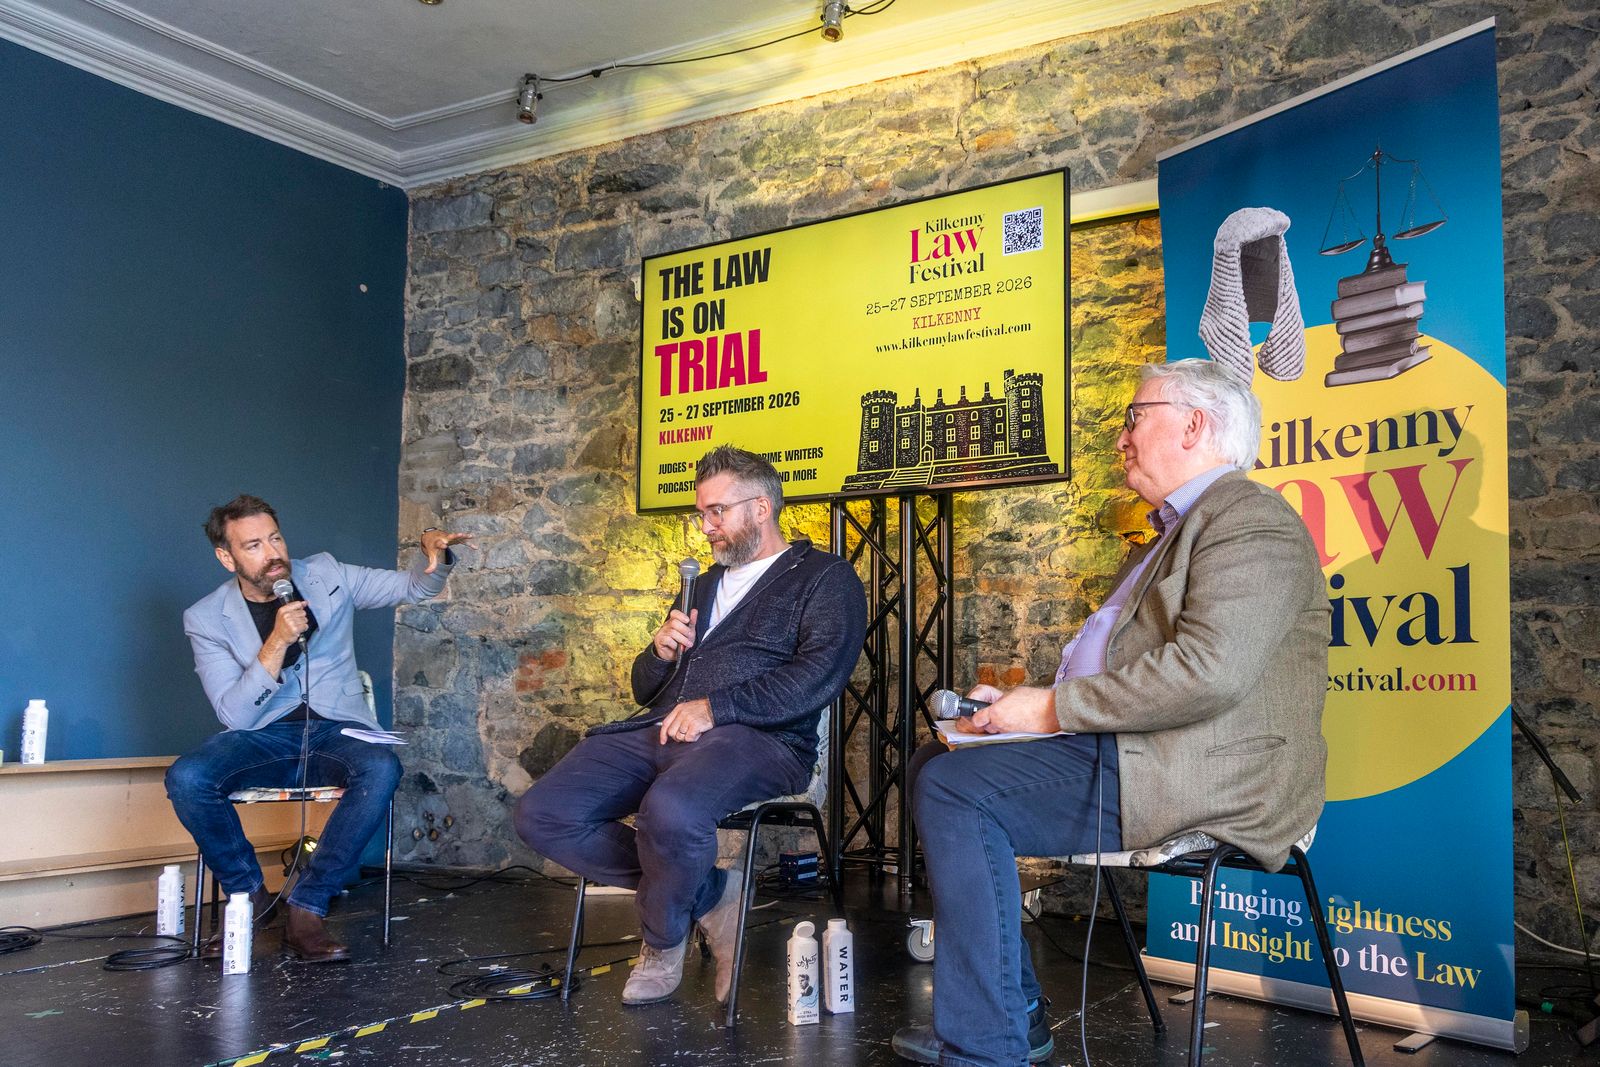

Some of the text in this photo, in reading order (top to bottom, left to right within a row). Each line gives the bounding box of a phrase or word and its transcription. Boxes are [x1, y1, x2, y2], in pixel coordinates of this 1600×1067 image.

[925, 213, 985, 234] Kilkenny
[909, 227, 985, 264] Law
[659, 248, 771, 301] THE LAW
[909, 253, 985, 284] Festival
[910, 283, 991, 308] SEPTEMBER
[997, 276, 1033, 293] 2026
[662, 299, 726, 340] IS ON
[912, 307, 982, 329] KILKENNY
[875, 323, 1032, 353] www.kilkennylawfestival.com
[654, 329, 768, 397] TRIAL
[659, 408, 674, 423] 25
[686, 404, 699, 420] 27
[702, 395, 764, 418] SEPTEMBER
[768, 391, 800, 409] 2026
[659, 425, 713, 445] KILKENNY
[1254, 405, 1473, 470] ilkenny
[658, 461, 687, 475] JUDGES
[785, 446, 824, 462] WRITERS
[792, 469, 817, 482] MORE
[1274, 458, 1475, 568] aw
[1328, 562, 1480, 648] ival
[1326, 667, 1477, 692] estival.com
[1189, 879, 1303, 927] Binging
[1222, 922, 1314, 964] Insight
[1323, 945, 1350, 968] o
[1358, 944, 1408, 977] the
[1416, 951, 1482, 990] Law
[839, 946, 849, 1003] WATER
